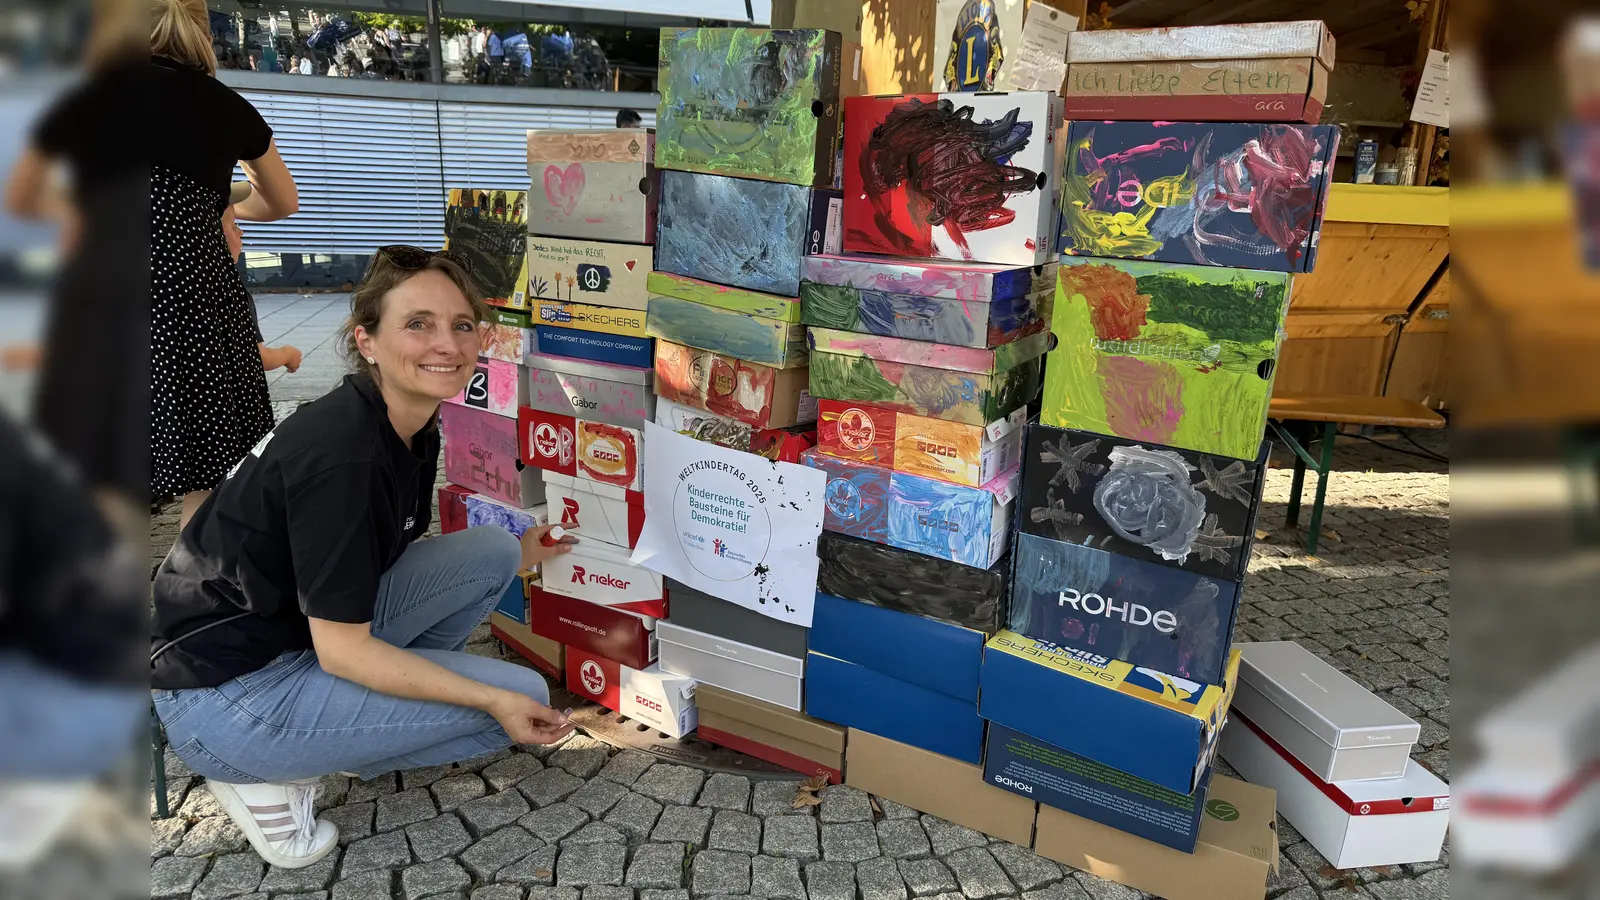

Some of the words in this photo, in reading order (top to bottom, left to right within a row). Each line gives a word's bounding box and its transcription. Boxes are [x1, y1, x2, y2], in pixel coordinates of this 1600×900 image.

[1255, 100, 1286, 111] ara
[578, 312, 640, 329] SKECHERS
[554, 334, 578, 343] COMFORT
[580, 337, 614, 348] TECHNOLOGY
[572, 396, 598, 410] Gabor
[678, 460, 746, 482] WELTKINDERTAG
[746, 480, 767, 504] 2025
[687, 483, 745, 508] Kinderrechte
[689, 497, 734, 518] Bausteine
[737, 510, 750, 522] für
[691, 510, 746, 534] Demokratie!
[589, 574, 631, 590] rieker
[558, 616, 606, 636] www.rollingsoft.de
[997, 638, 1115, 682] SKECHERS
